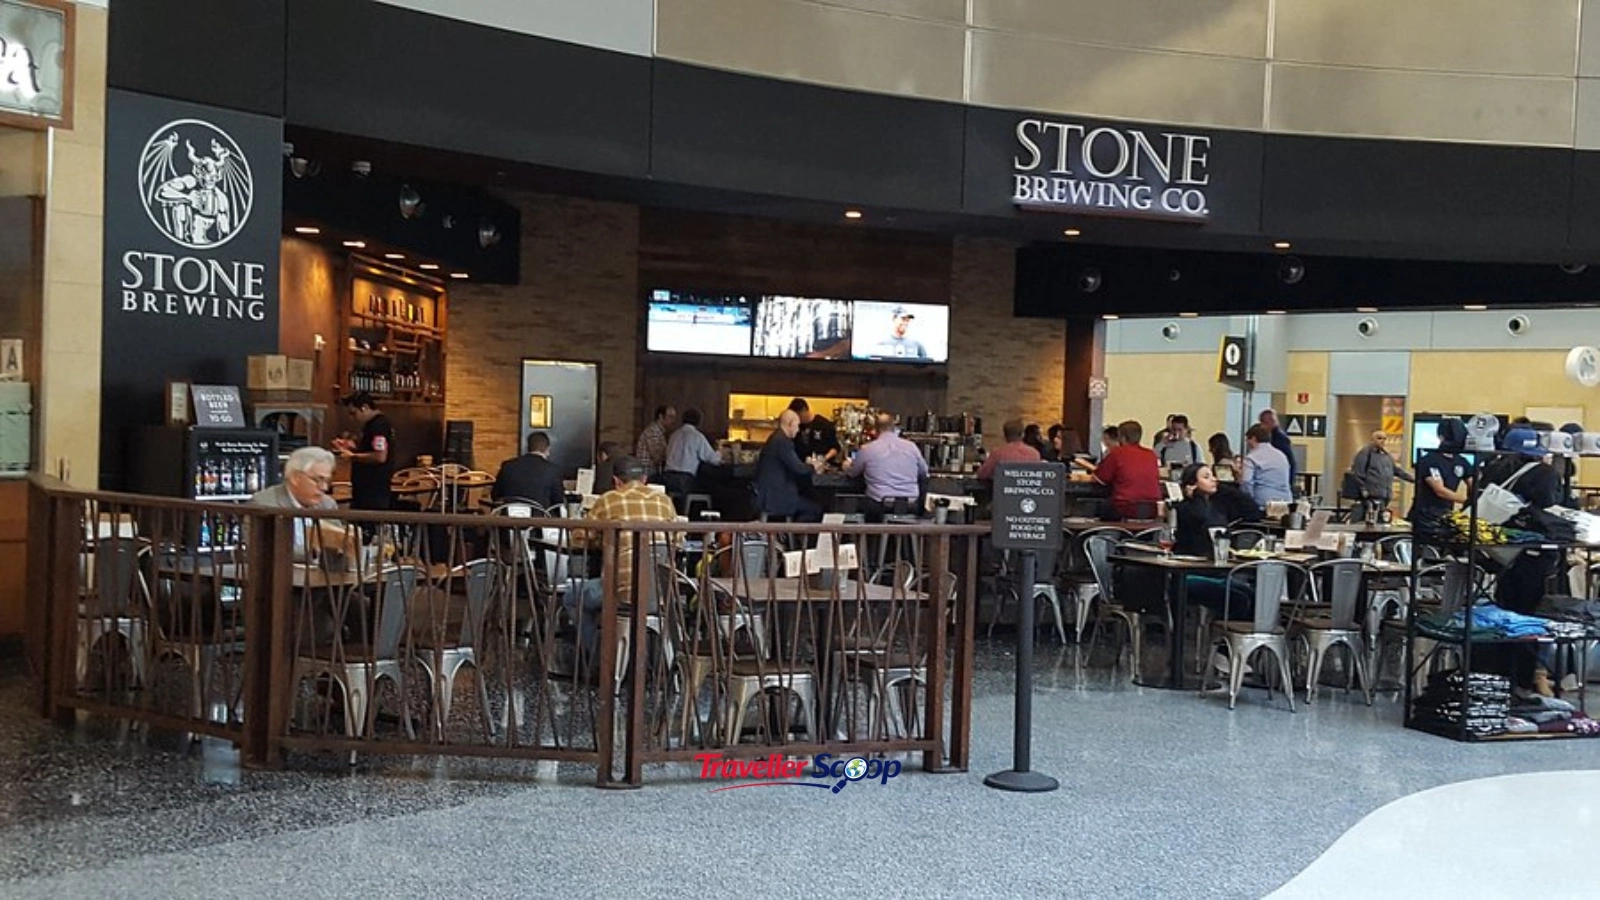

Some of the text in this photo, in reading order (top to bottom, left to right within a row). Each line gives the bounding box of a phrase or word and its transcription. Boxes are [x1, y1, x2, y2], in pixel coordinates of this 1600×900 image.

[1014, 119, 1210, 185] STONE
[1014, 174, 1210, 215] BREWING CO.
[121, 250, 265, 299] STONE
[121, 290, 265, 321] BREWING
[1003, 469, 1057, 479] WELCOME TO
[1016, 479, 1042, 487] STONE
[1003, 487, 1040, 495] BREWING
[1018, 516, 1052, 524] OUTSIDE
[1009, 532, 1046, 540] BEVERAGE
